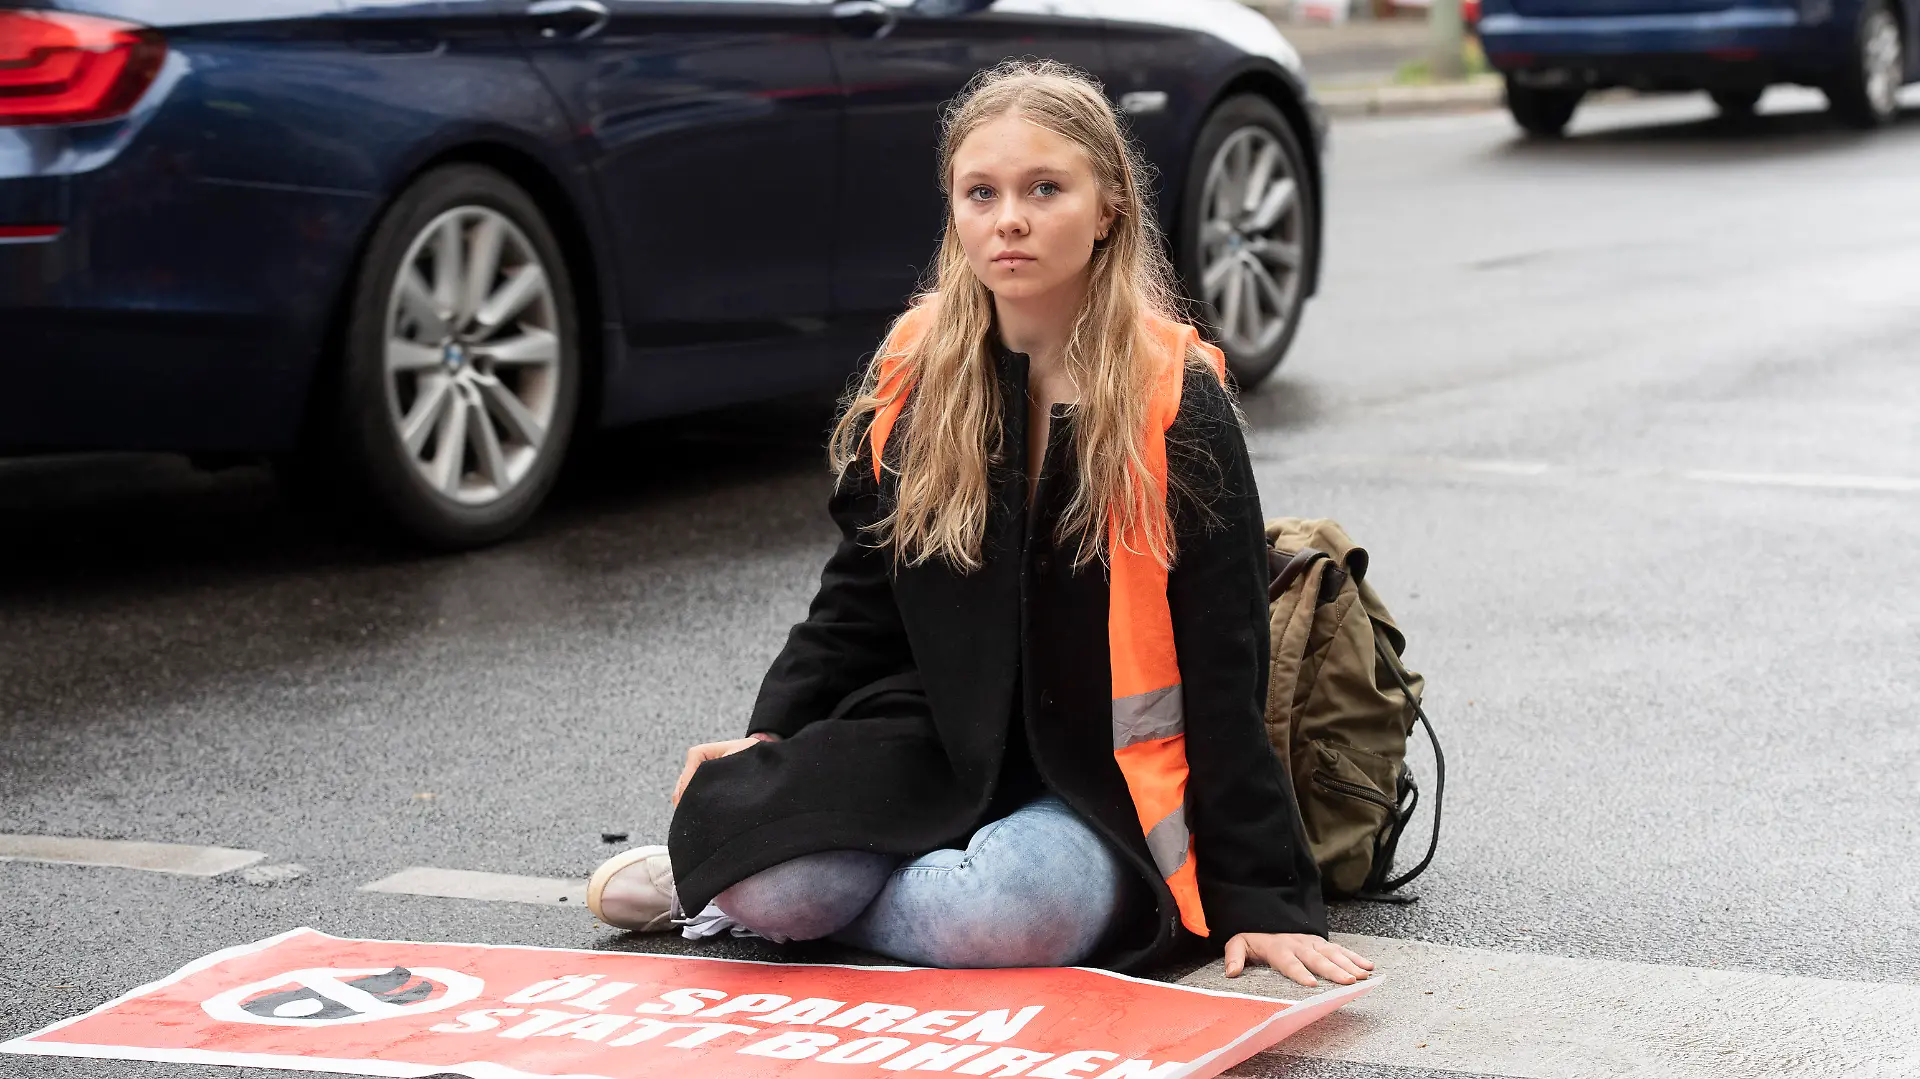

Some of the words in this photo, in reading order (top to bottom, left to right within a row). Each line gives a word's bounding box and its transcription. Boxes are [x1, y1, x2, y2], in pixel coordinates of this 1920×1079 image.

[428, 1008, 759, 1049] STATT
[503, 974, 638, 1010] ÖL
[635, 988, 1045, 1042] SPAREN
